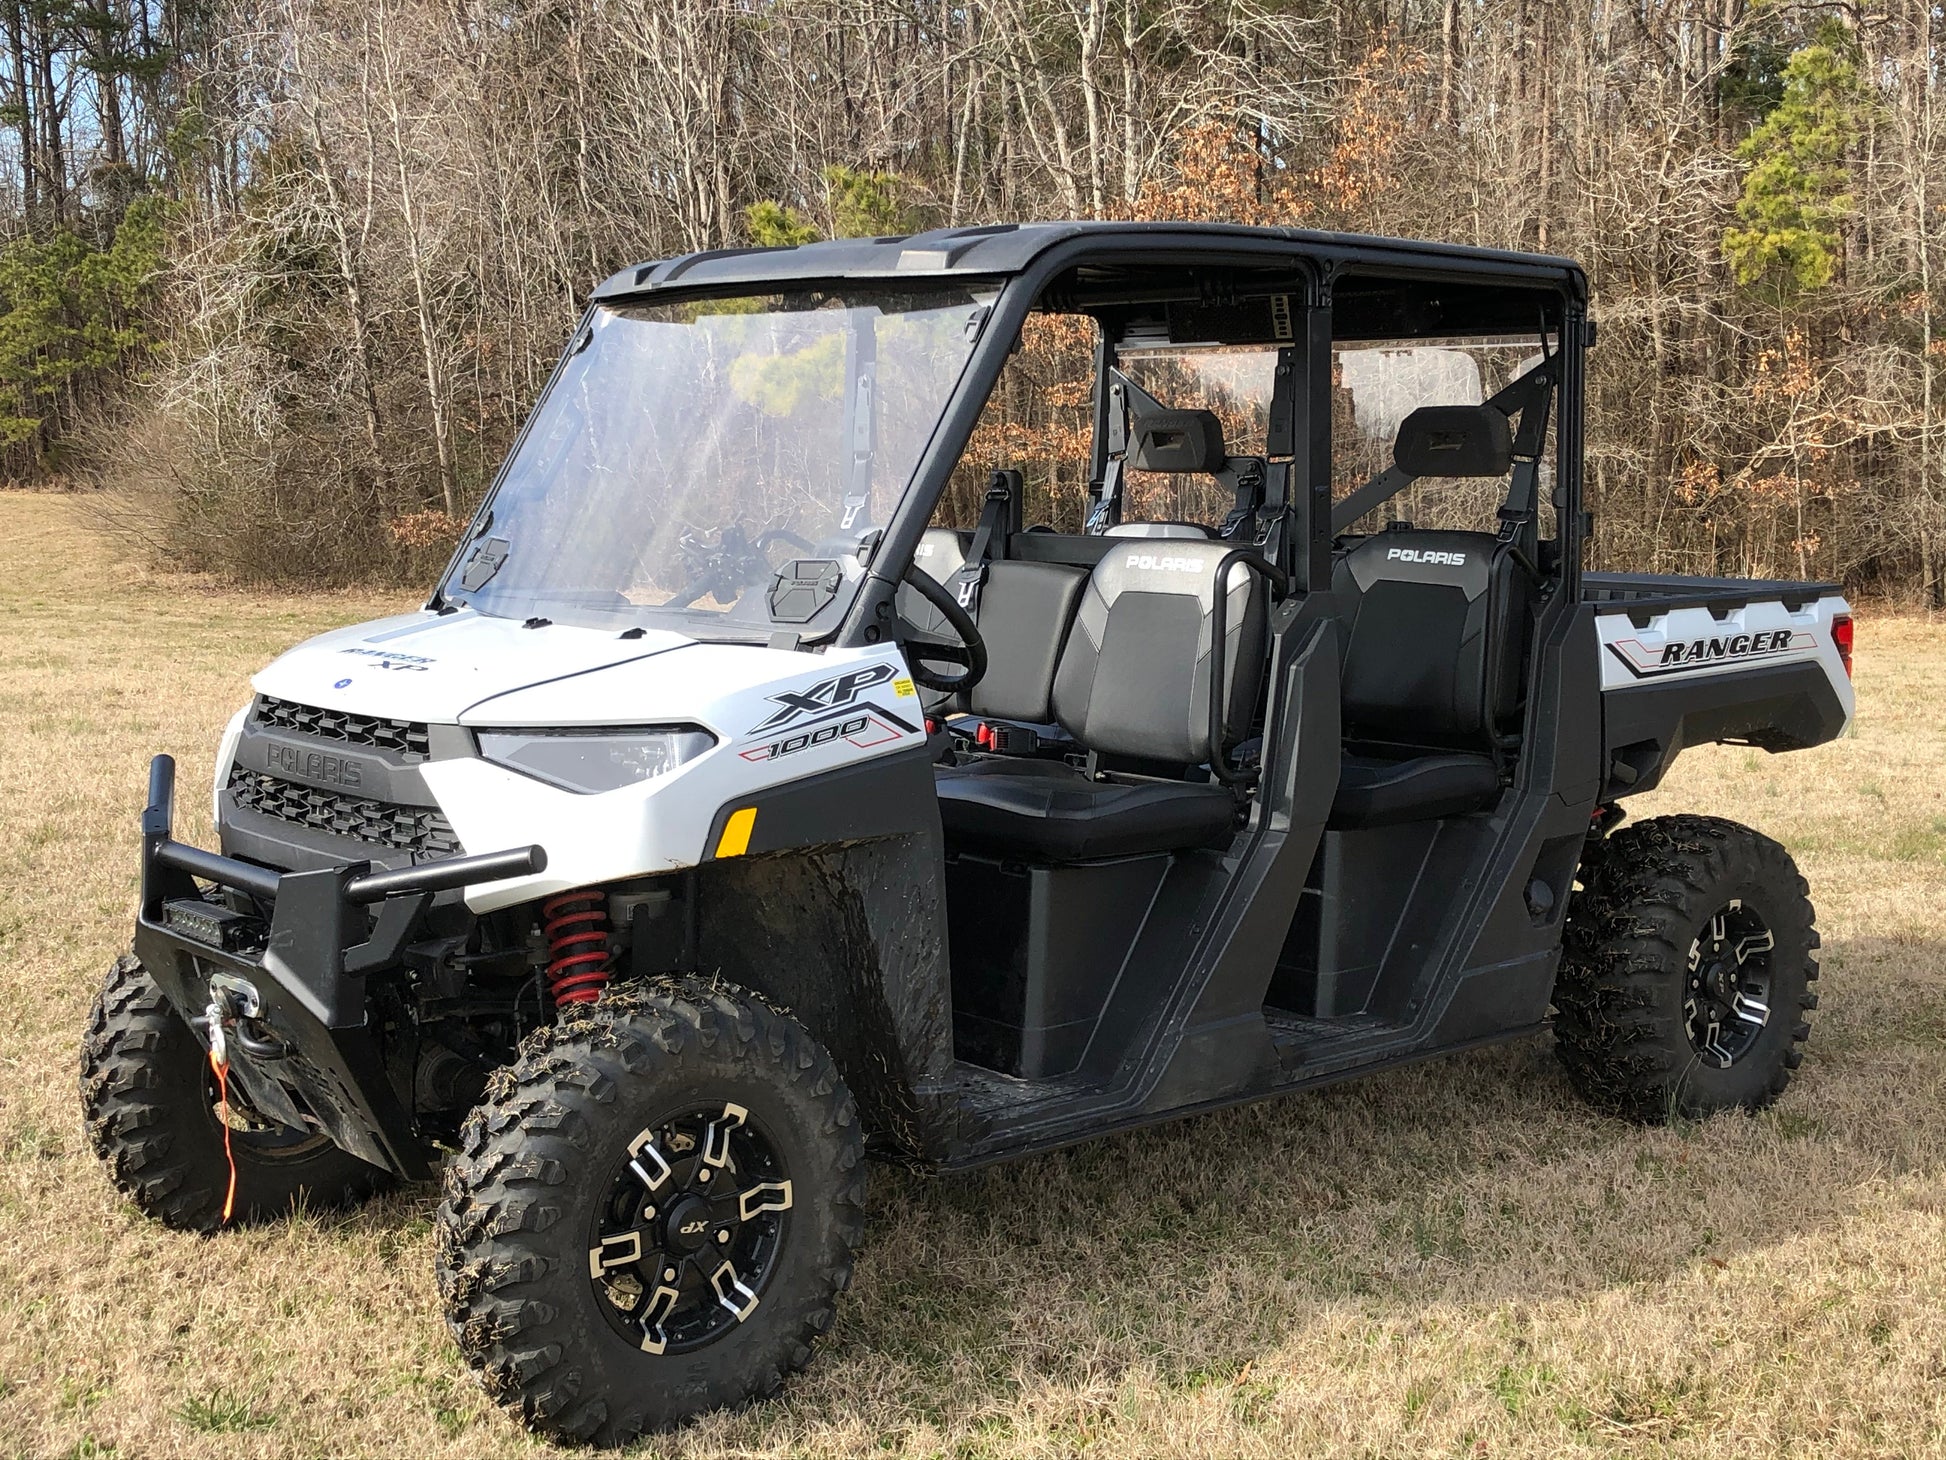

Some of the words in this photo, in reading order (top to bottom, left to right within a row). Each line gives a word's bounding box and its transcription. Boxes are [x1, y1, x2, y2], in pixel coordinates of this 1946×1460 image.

[1126, 555, 1205, 573] POLARIS
[1387, 548, 1466, 566] POLARIS
[1658, 629, 1794, 668] RANGER
[746, 661, 900, 736] XP
[767, 715, 870, 761] 1000
[267, 743, 362, 789] POLARIS
[680, 1220, 710, 1234] XP
